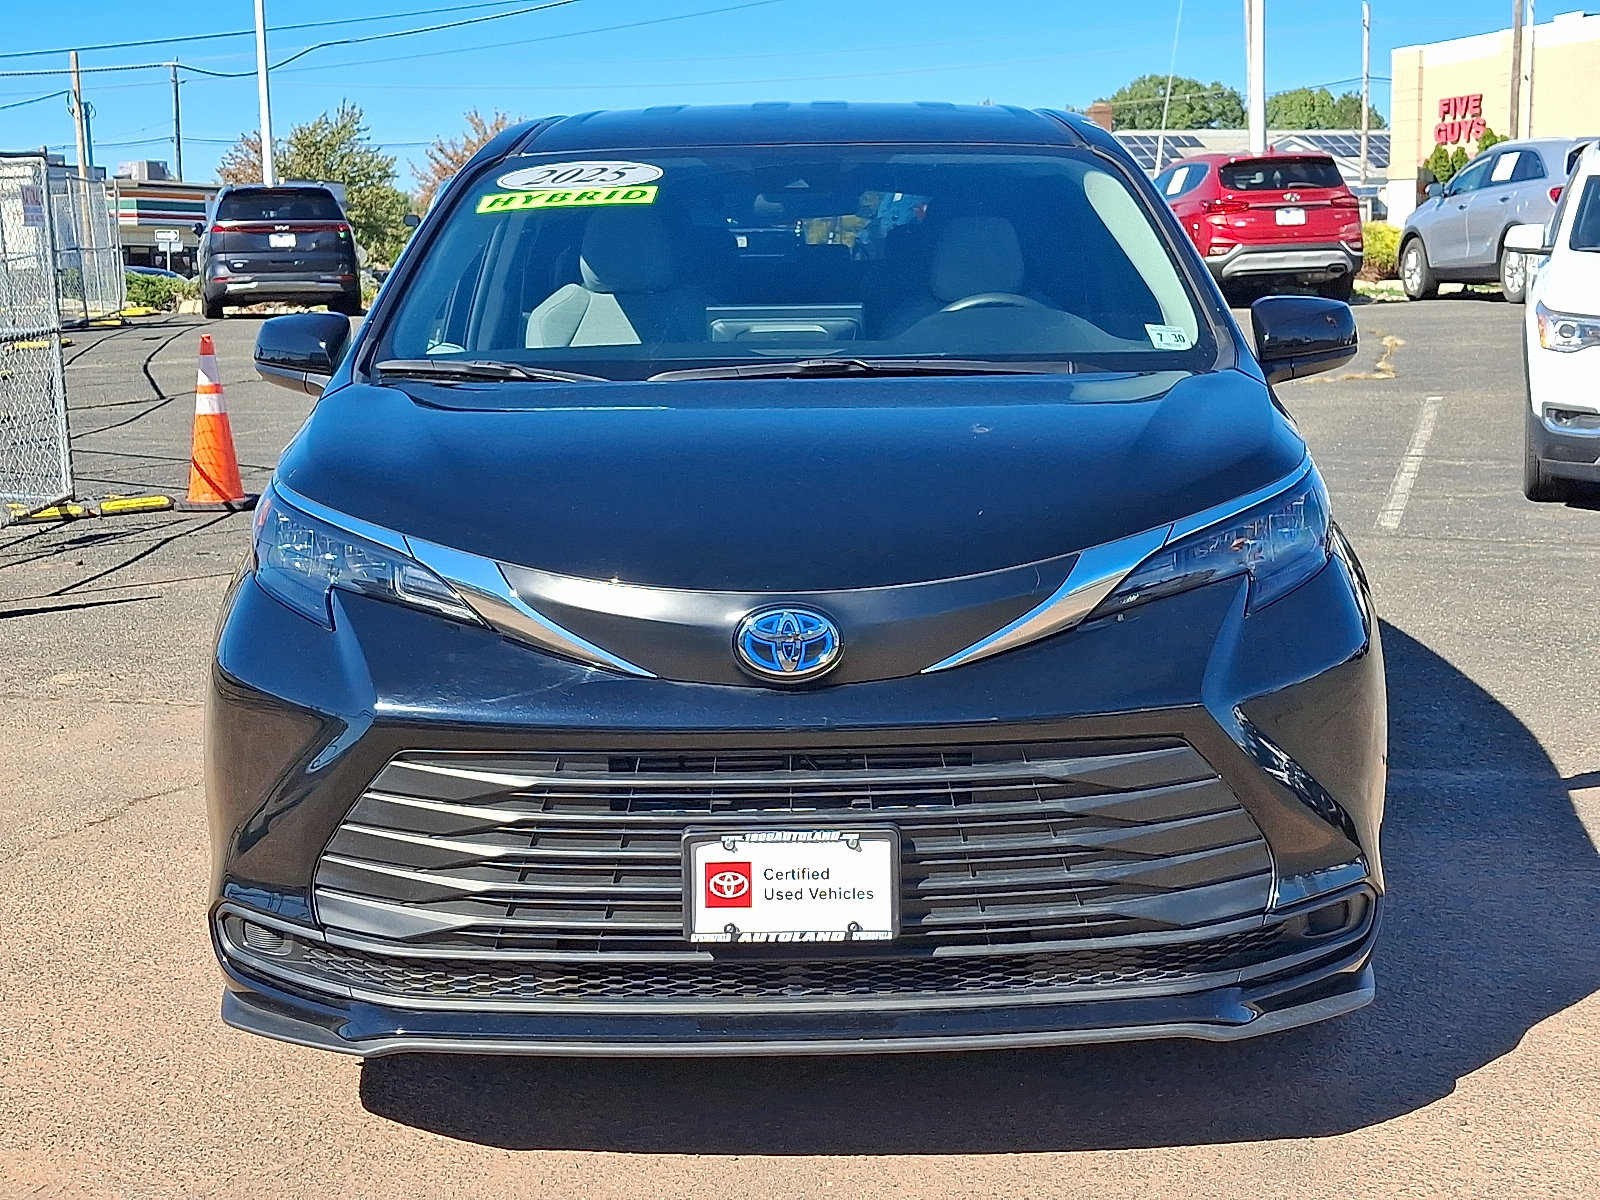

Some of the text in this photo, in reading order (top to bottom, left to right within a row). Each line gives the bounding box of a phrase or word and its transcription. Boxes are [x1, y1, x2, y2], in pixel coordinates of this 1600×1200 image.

[1439, 94, 1483, 121] FIVE
[1434, 118, 1486, 145] GUYS
[520, 166, 638, 186] 2025
[486, 189, 648, 209] HYBRID
[1156, 332, 1186, 343] 7 30
[763, 868, 830, 880] Certified
[764, 887, 874, 900] Used Vehicles
[738, 931, 846, 943] AUTOLAND
